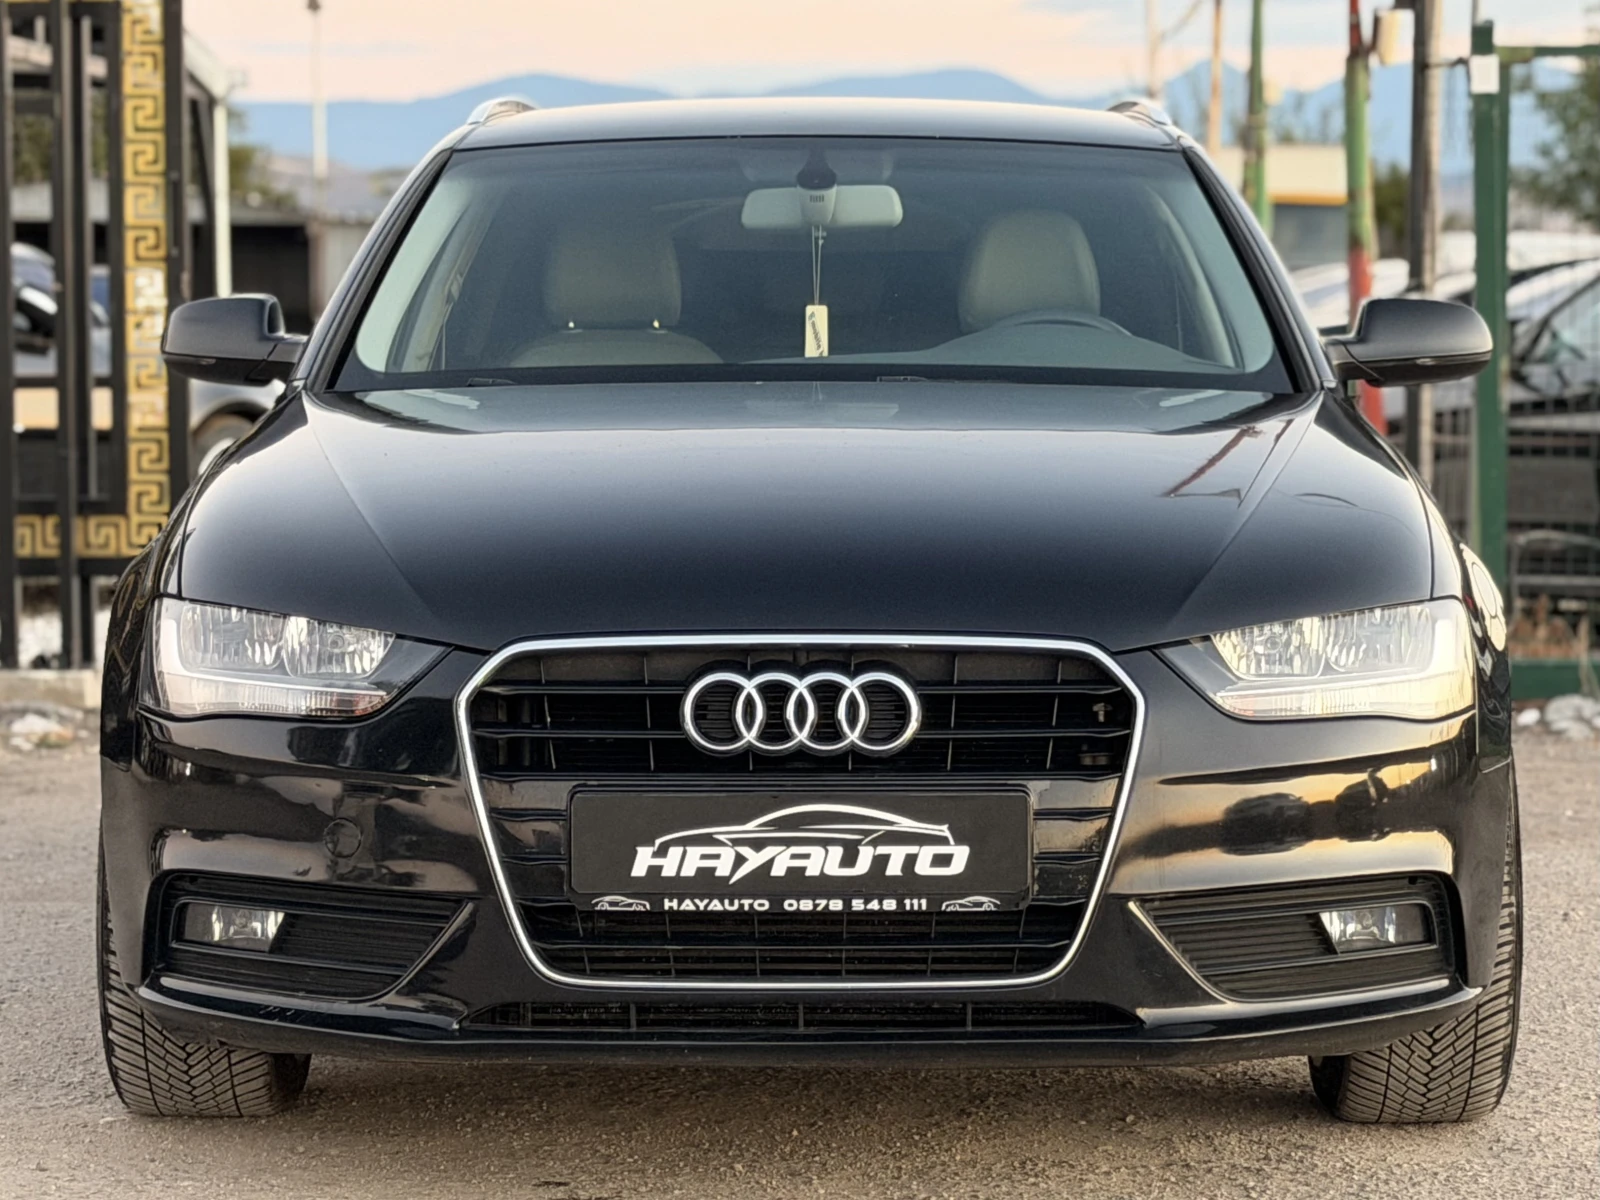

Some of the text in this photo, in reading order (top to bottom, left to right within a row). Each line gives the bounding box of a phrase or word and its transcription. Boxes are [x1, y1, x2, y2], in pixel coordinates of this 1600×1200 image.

[631, 845, 970, 884] HAYAUTO
[663, 898, 927, 911] HAYAUTO 0878 548 111
